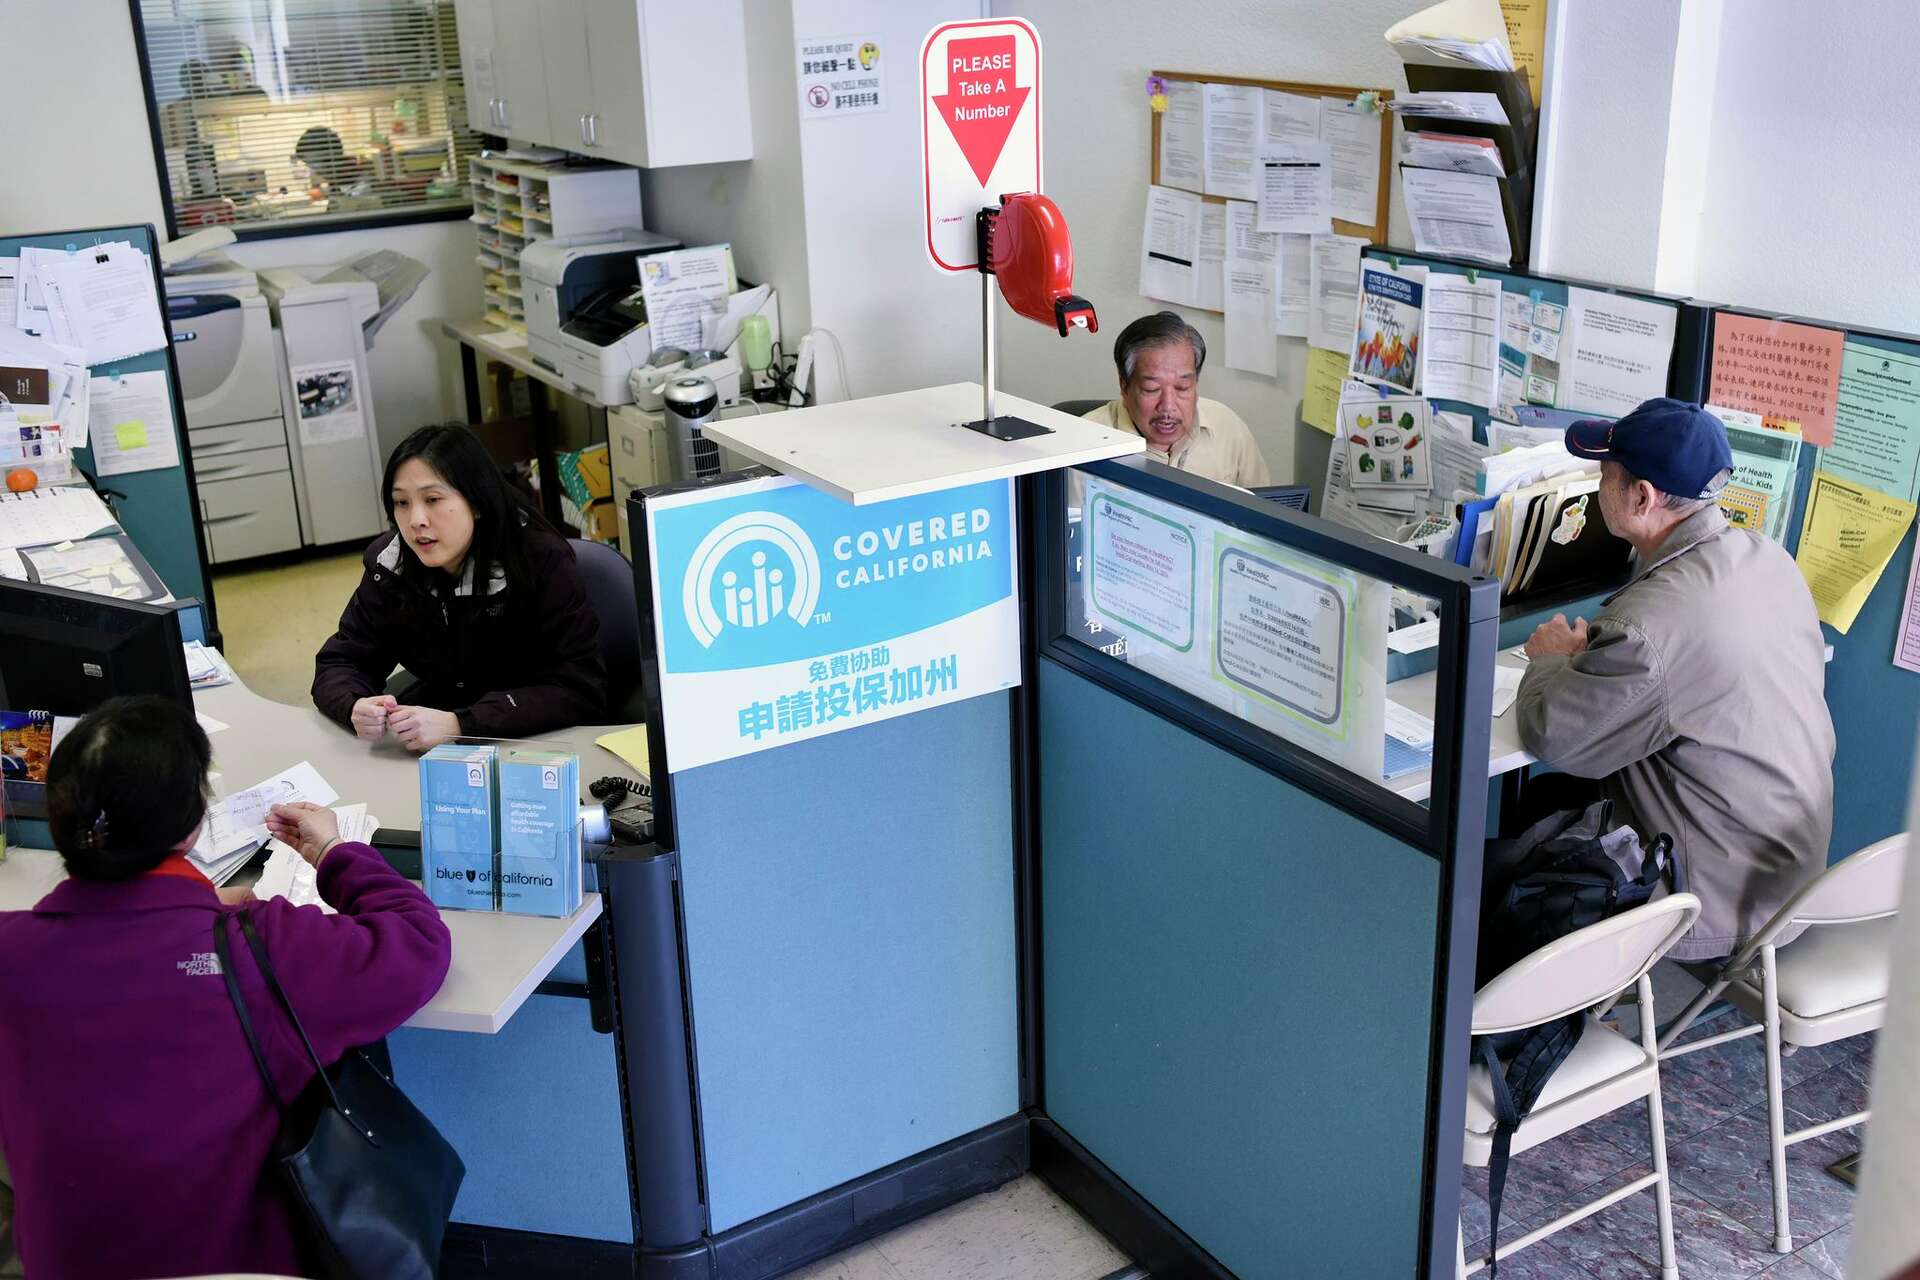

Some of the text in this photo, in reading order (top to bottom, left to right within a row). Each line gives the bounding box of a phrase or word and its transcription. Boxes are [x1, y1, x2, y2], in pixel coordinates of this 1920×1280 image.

[952, 54, 1012, 73] PLEASE
[959, 78, 1006, 97] Take A
[954, 104, 1011, 122] Number
[1747, 466, 1773, 480] Health
[1756, 479, 1773, 490] Kids
[833, 507, 992, 562] COVERED
[835, 539, 993, 590] CALIFORNIA
[814, 610, 832, 625] TM
[738, 653, 959, 742] 申請投保加州
[435, 804, 487, 815] Using Your Plan
[436, 868, 464, 881] blue
[478, 870, 492, 883] of
[191, 952, 209, 961] THE
[176, 960, 209, 970] NORTH
[186, 967, 209, 976] FACE
